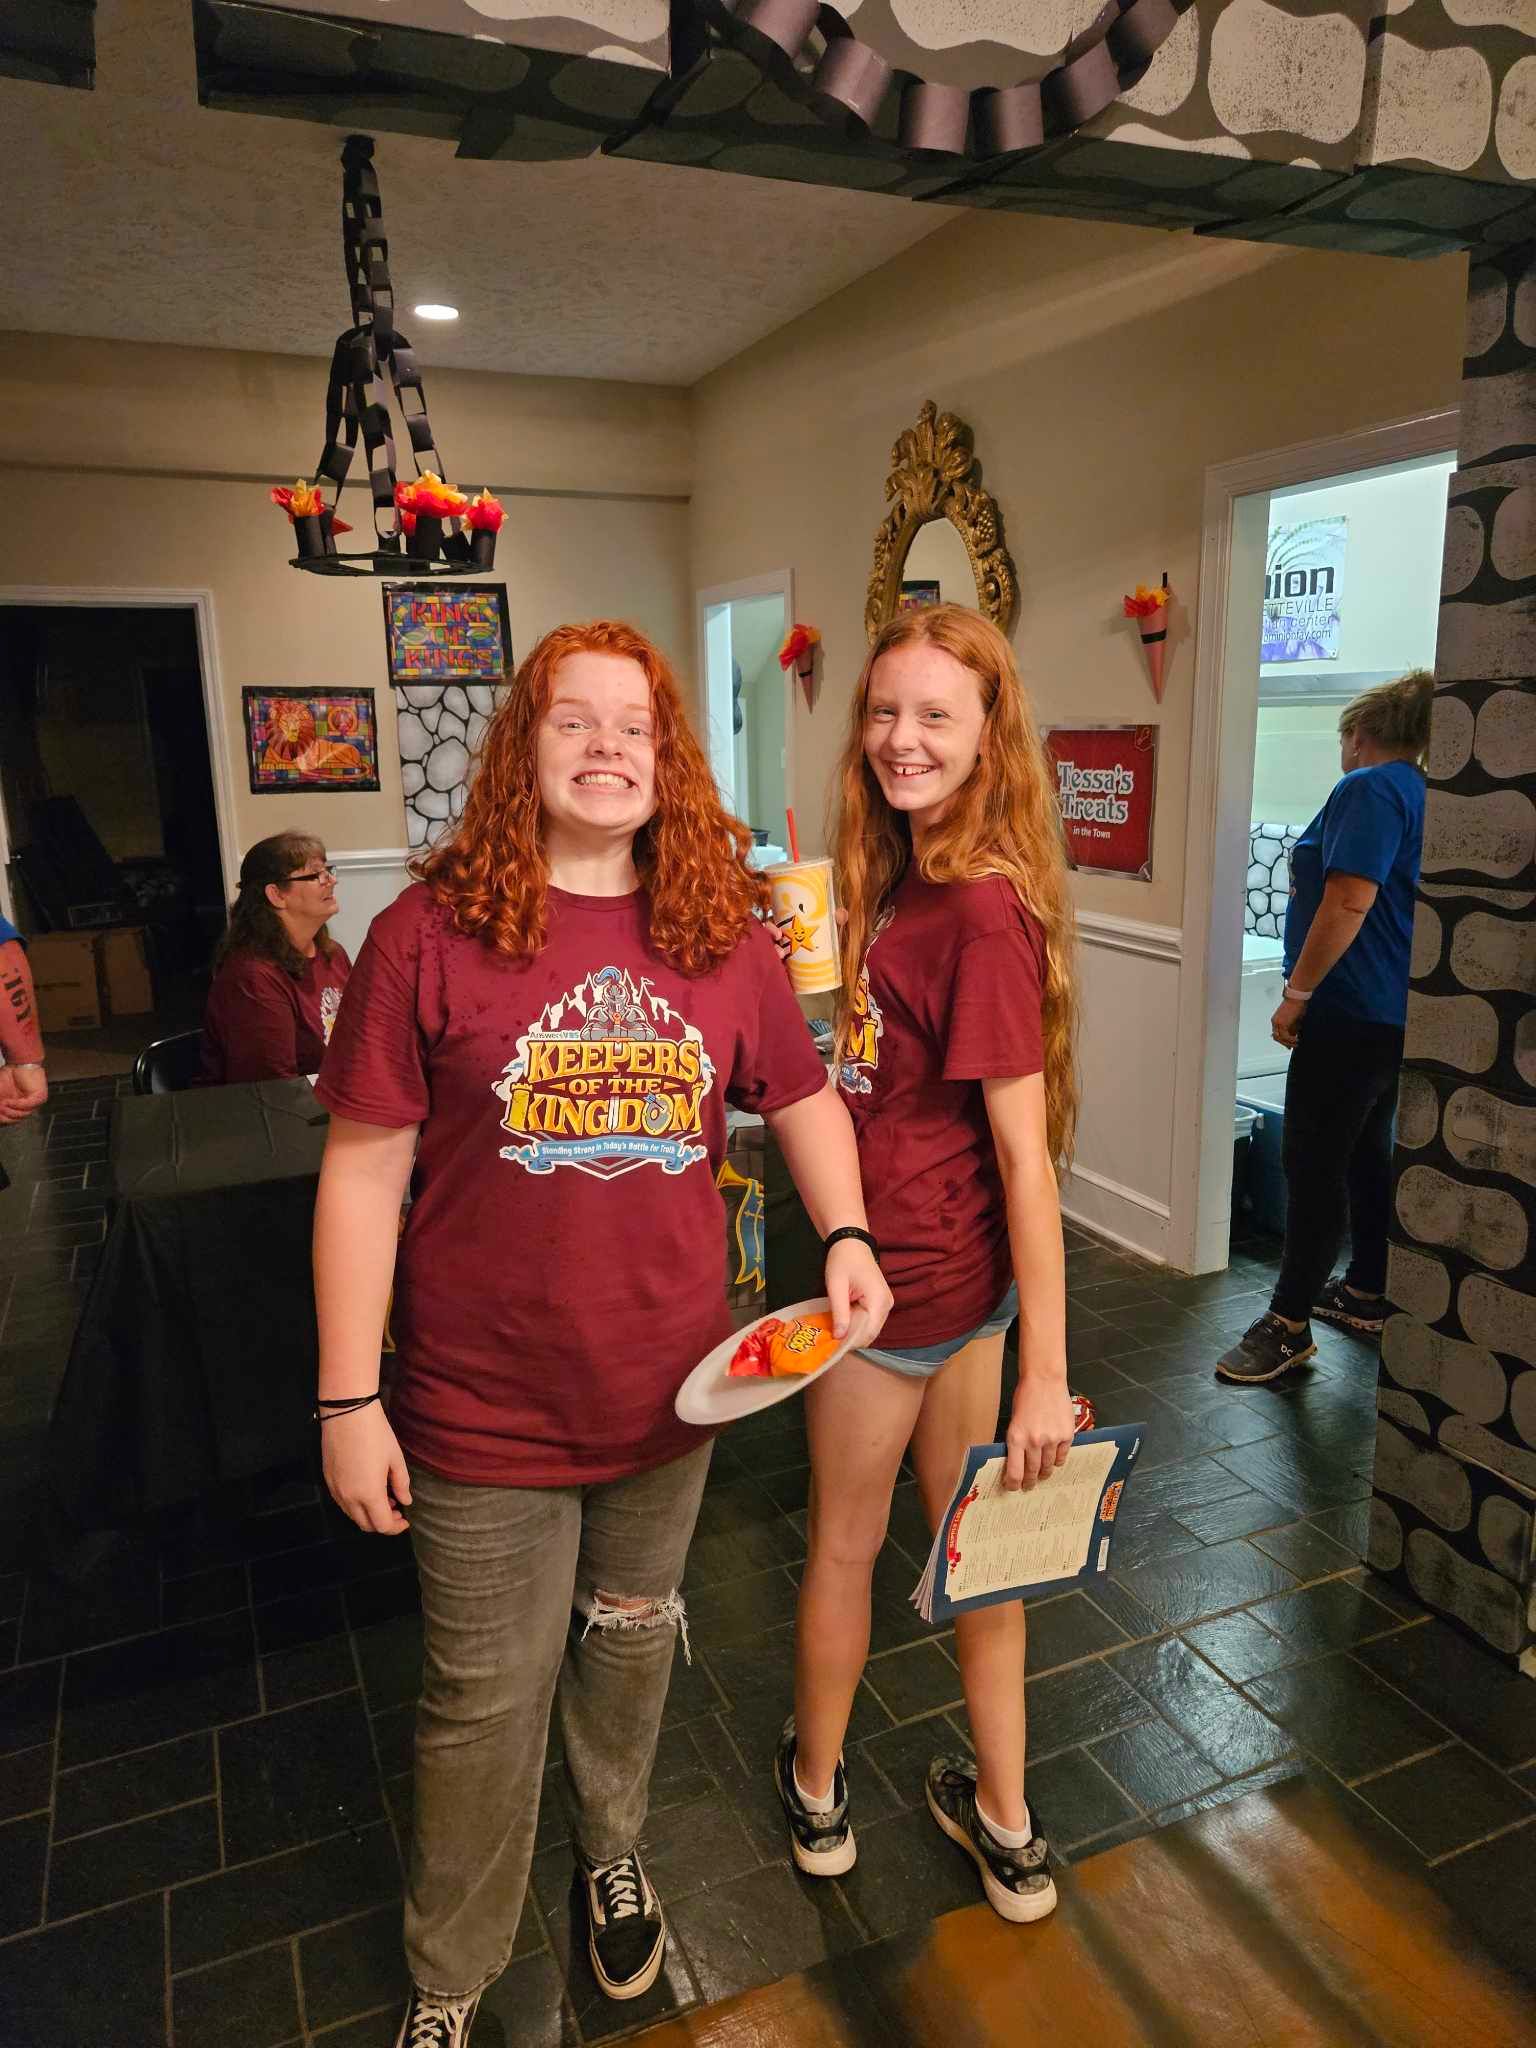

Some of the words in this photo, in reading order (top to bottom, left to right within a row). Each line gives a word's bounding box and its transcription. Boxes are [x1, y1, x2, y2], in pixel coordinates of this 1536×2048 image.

[410, 602, 481, 623] KING
[404, 647, 493, 670] KINGS
[1057, 762, 1133, 794] Tessa's
[1062, 791, 1128, 823] Treats
[527, 1041, 701, 1083] KEEPERS
[568, 1078, 603, 1096] OF
[609, 1077, 663, 1095] THE
[503, 1083, 703, 1136] KINGDOM
